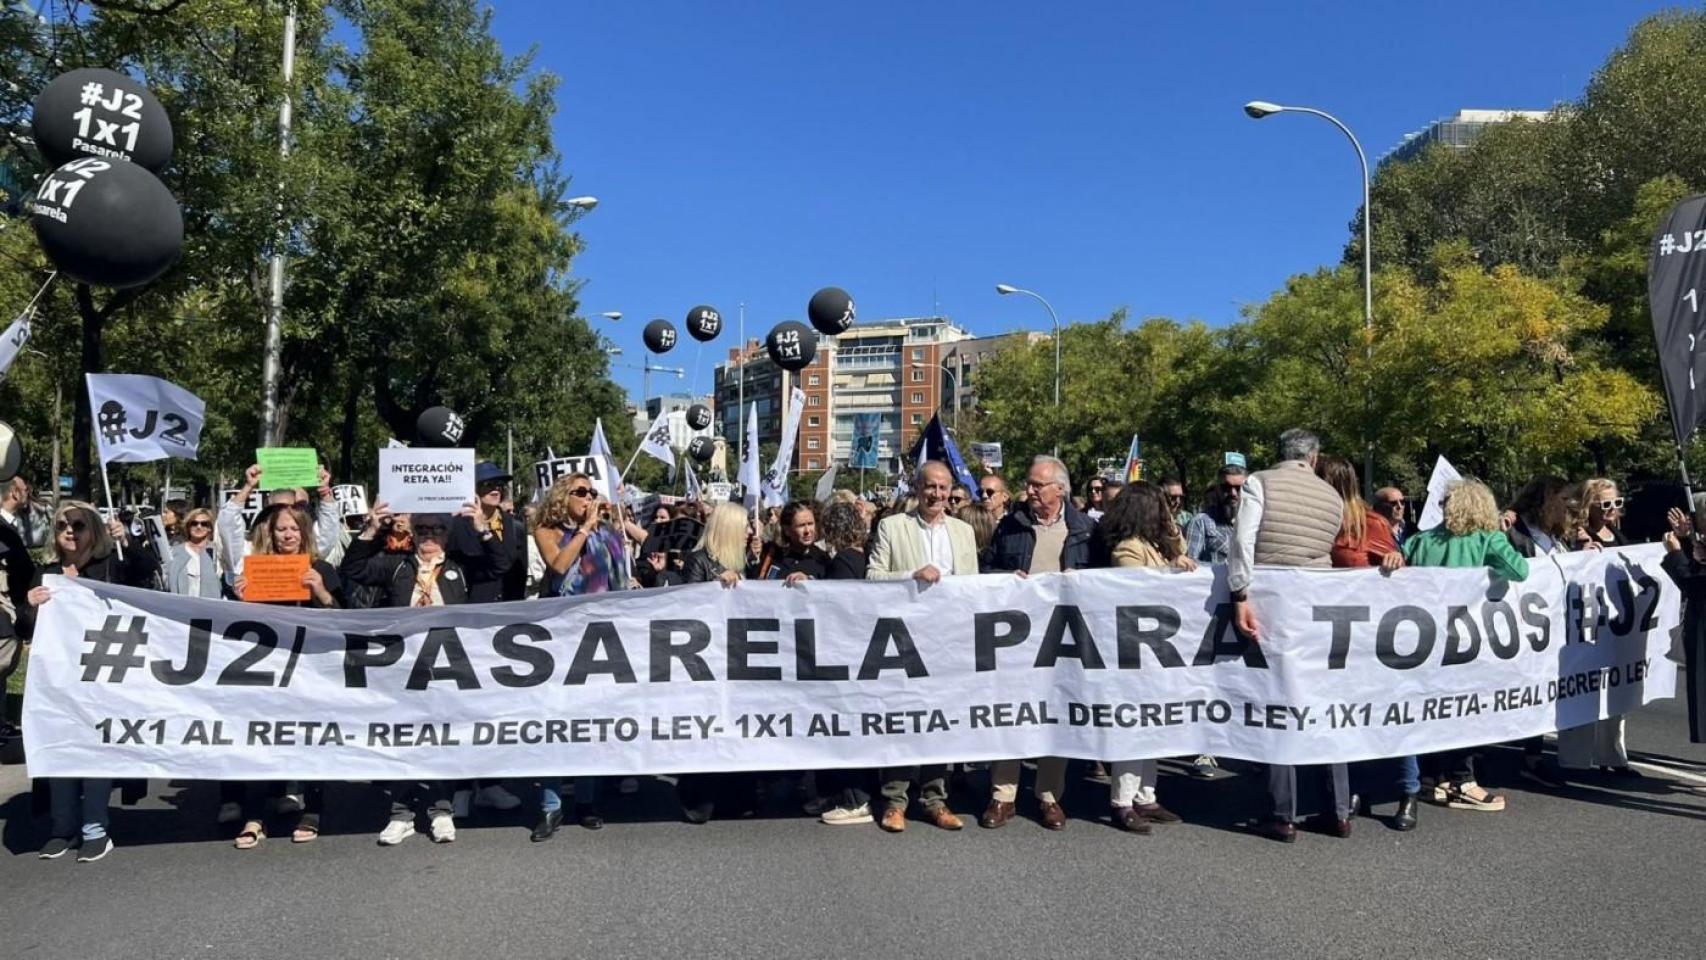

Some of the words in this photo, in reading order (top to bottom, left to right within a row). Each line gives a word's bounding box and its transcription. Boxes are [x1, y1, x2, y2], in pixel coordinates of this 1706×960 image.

[81, 82, 143, 120] #J2
[73, 107, 140, 151] 1x1
[72, 138, 132, 162] Pasarela
[776, 330, 800, 345] #J2
[776, 342, 801, 357] 1x1
[98, 401, 189, 447] #J2
[391, 461, 464, 474] INTEGRACIÓN
[403, 475, 430, 485] RETA
[431, 475, 452, 485] YA!!
[536, 456, 602, 489] RETA
[80, 614, 307, 688] #J2/
[343, 618, 930, 691] PASARELA
[974, 600, 1270, 673] PARA
[1312, 592, 1551, 670] TODOS
[1565, 575, 1662, 645] #J2
[95, 718, 166, 745] 1X1
[182, 720, 233, 746] AL
[246, 720, 355, 746] RETA-
[367, 722, 460, 747] REAL
[472, 717, 640, 746] DECRETO
[651, 715, 724, 741] LEY-
[735, 713, 793, 738] 1X1
[807, 713, 850, 737] AL
[861, 709, 960, 736] RETA-
[969, 701, 1059, 729] REAL
[1068, 700, 1232, 728] DECRETO
[1244, 701, 1317, 732] LEY-
[1325, 702, 1372, 730] 1X1
[1382, 701, 1415, 726] AL
[1421, 693, 1488, 722] RETA-
[1493, 685, 1543, 713] REAL
[1548, 666, 1621, 702] DECRETO
[1626, 657, 1652, 685] LEY
